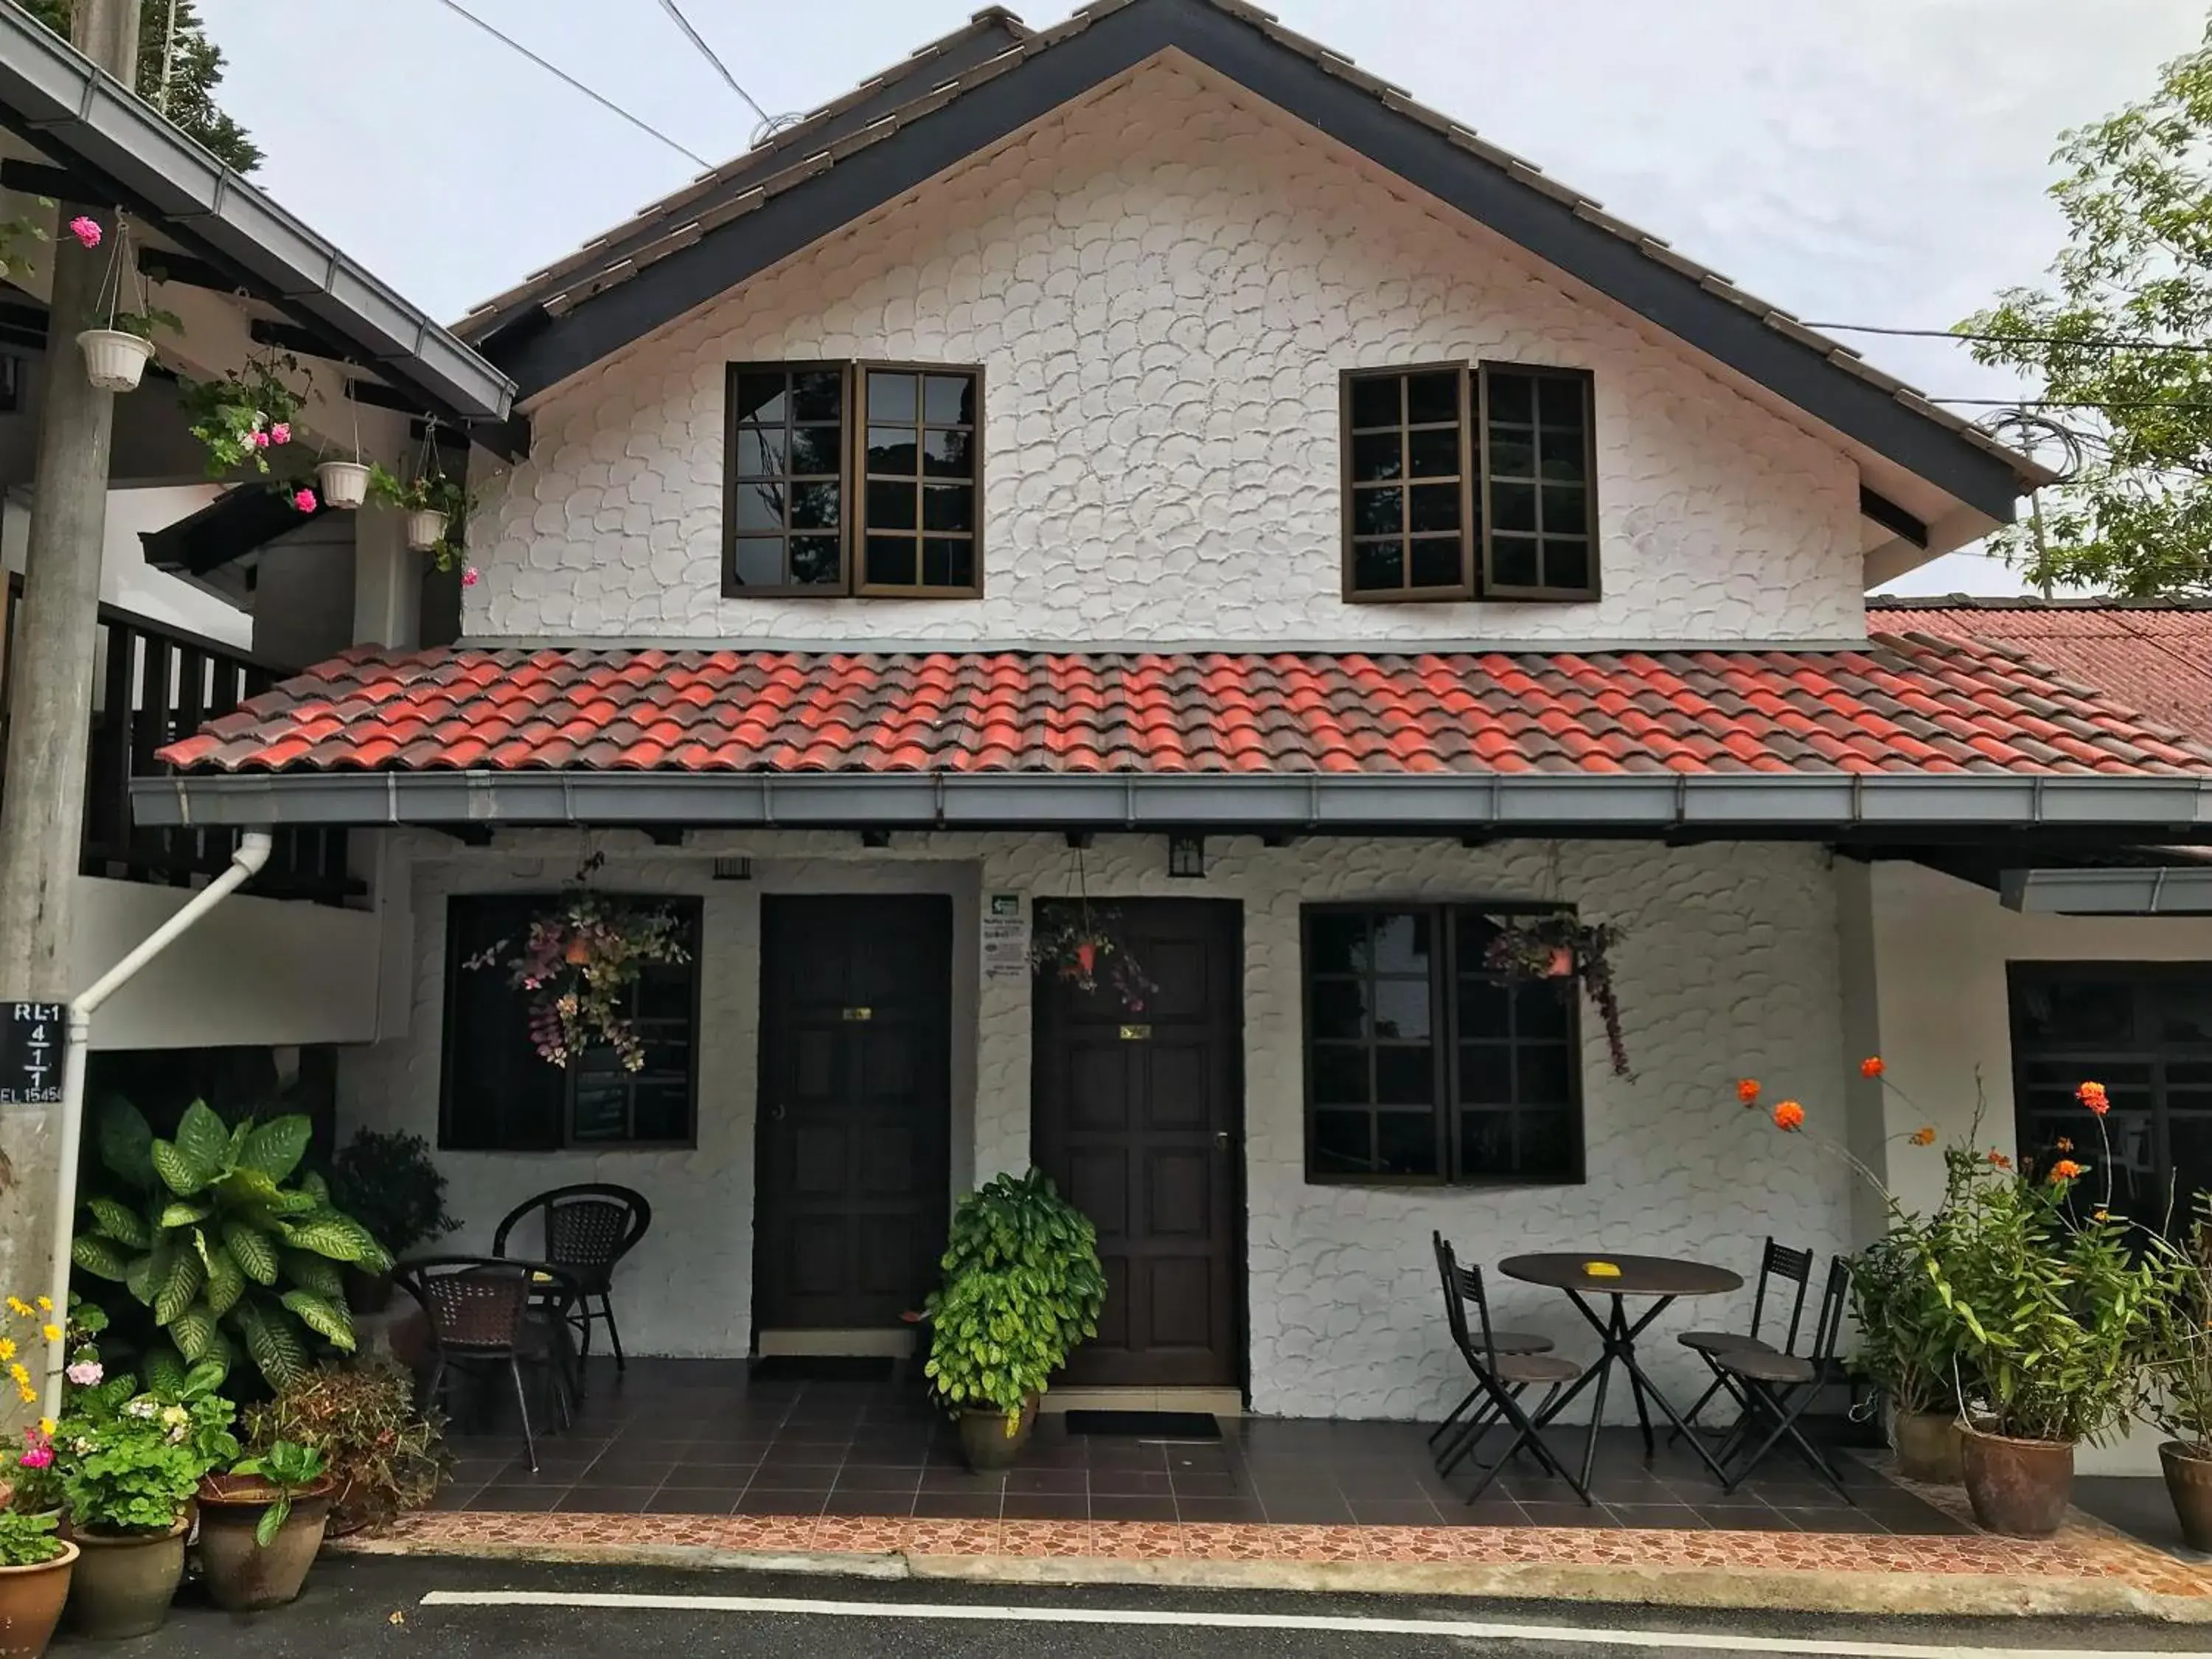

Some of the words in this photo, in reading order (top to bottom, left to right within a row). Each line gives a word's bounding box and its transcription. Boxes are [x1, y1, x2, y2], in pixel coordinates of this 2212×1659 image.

[32, 1024, 45, 1041] 4
[32, 1048, 41, 1065] 1
[31, 1071, 41, 1088] 1
